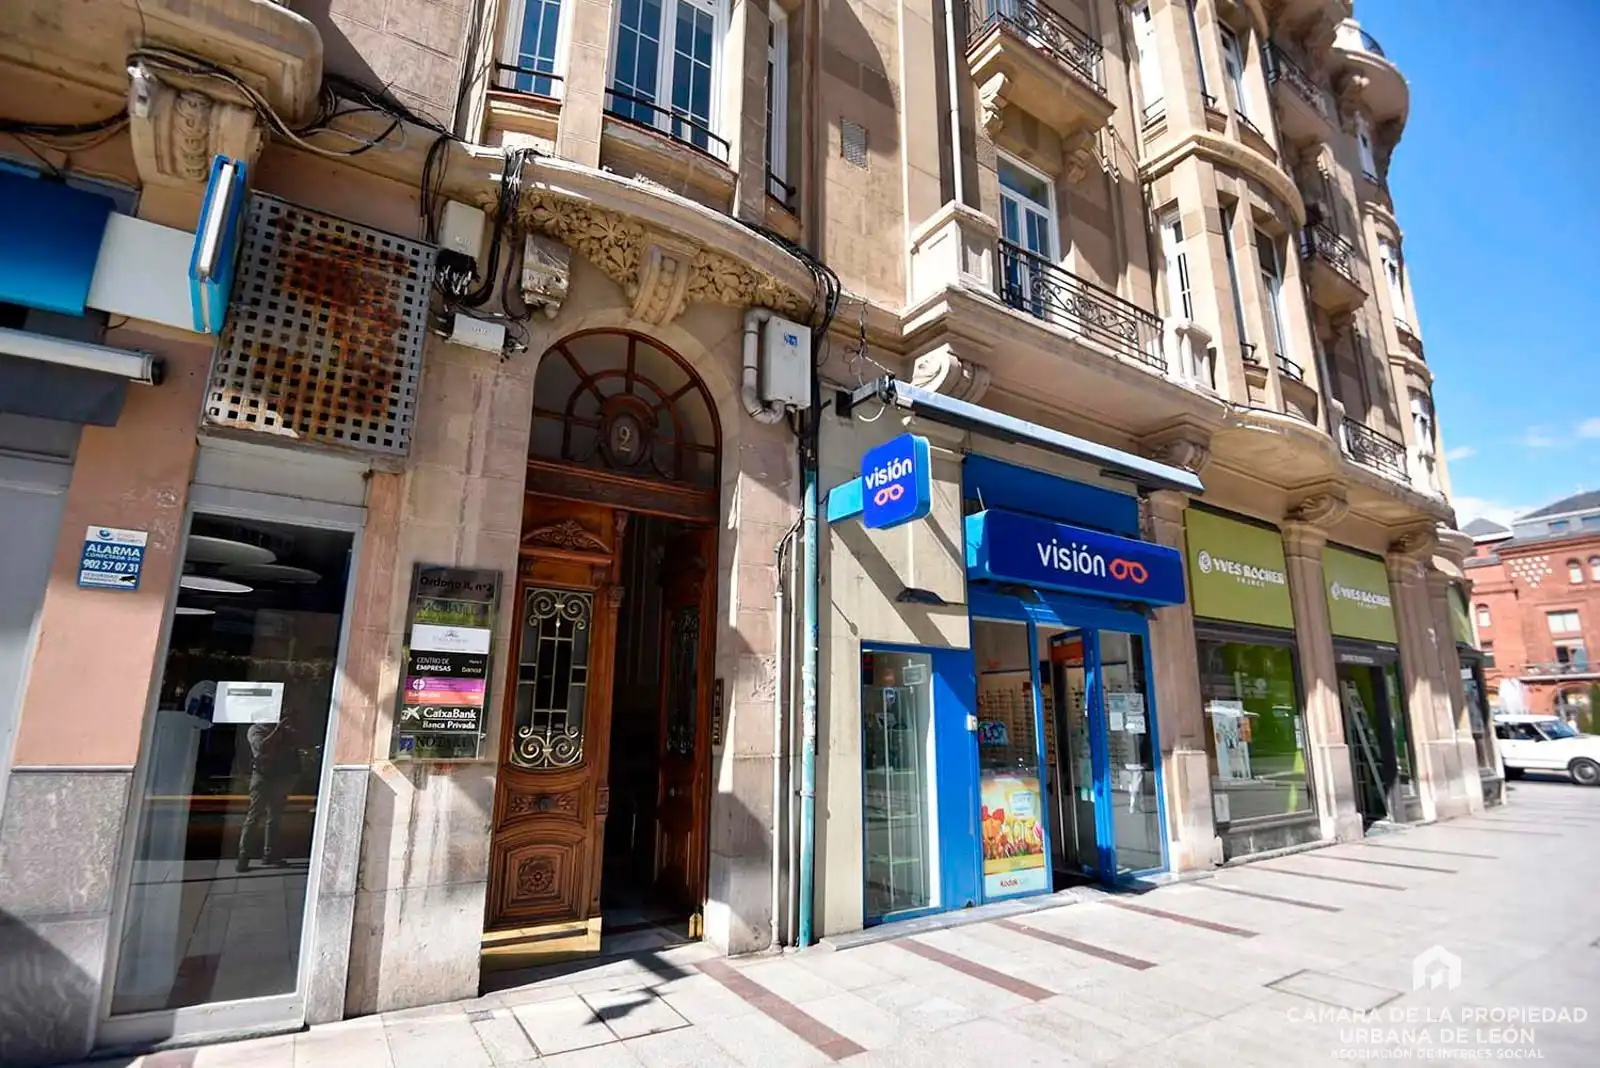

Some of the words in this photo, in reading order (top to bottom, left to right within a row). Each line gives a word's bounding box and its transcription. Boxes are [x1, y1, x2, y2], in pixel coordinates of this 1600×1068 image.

[620, 426, 631, 452] 2
[865, 457, 913, 490] visión
[87, 544, 140, 557] ALARMA
[1037, 538, 1106, 578] visión
[83, 559, 100, 570] 902
[101, 561, 114, 570] 57
[115, 562, 127, 572] 07
[128, 563, 139, 573] 31
[1212, 558, 1242, 576] YVES
[1243, 565, 1285, 585] ROCHER
[1340, 587, 1361, 601] YVES
[416, 656, 441, 664] CENTRO
[416, 664, 452, 672] EMPRESAS
[423, 707, 477, 719] CaixaBank
[422, 720, 446, 729] Banca
[446, 720, 476, 730] Privada
